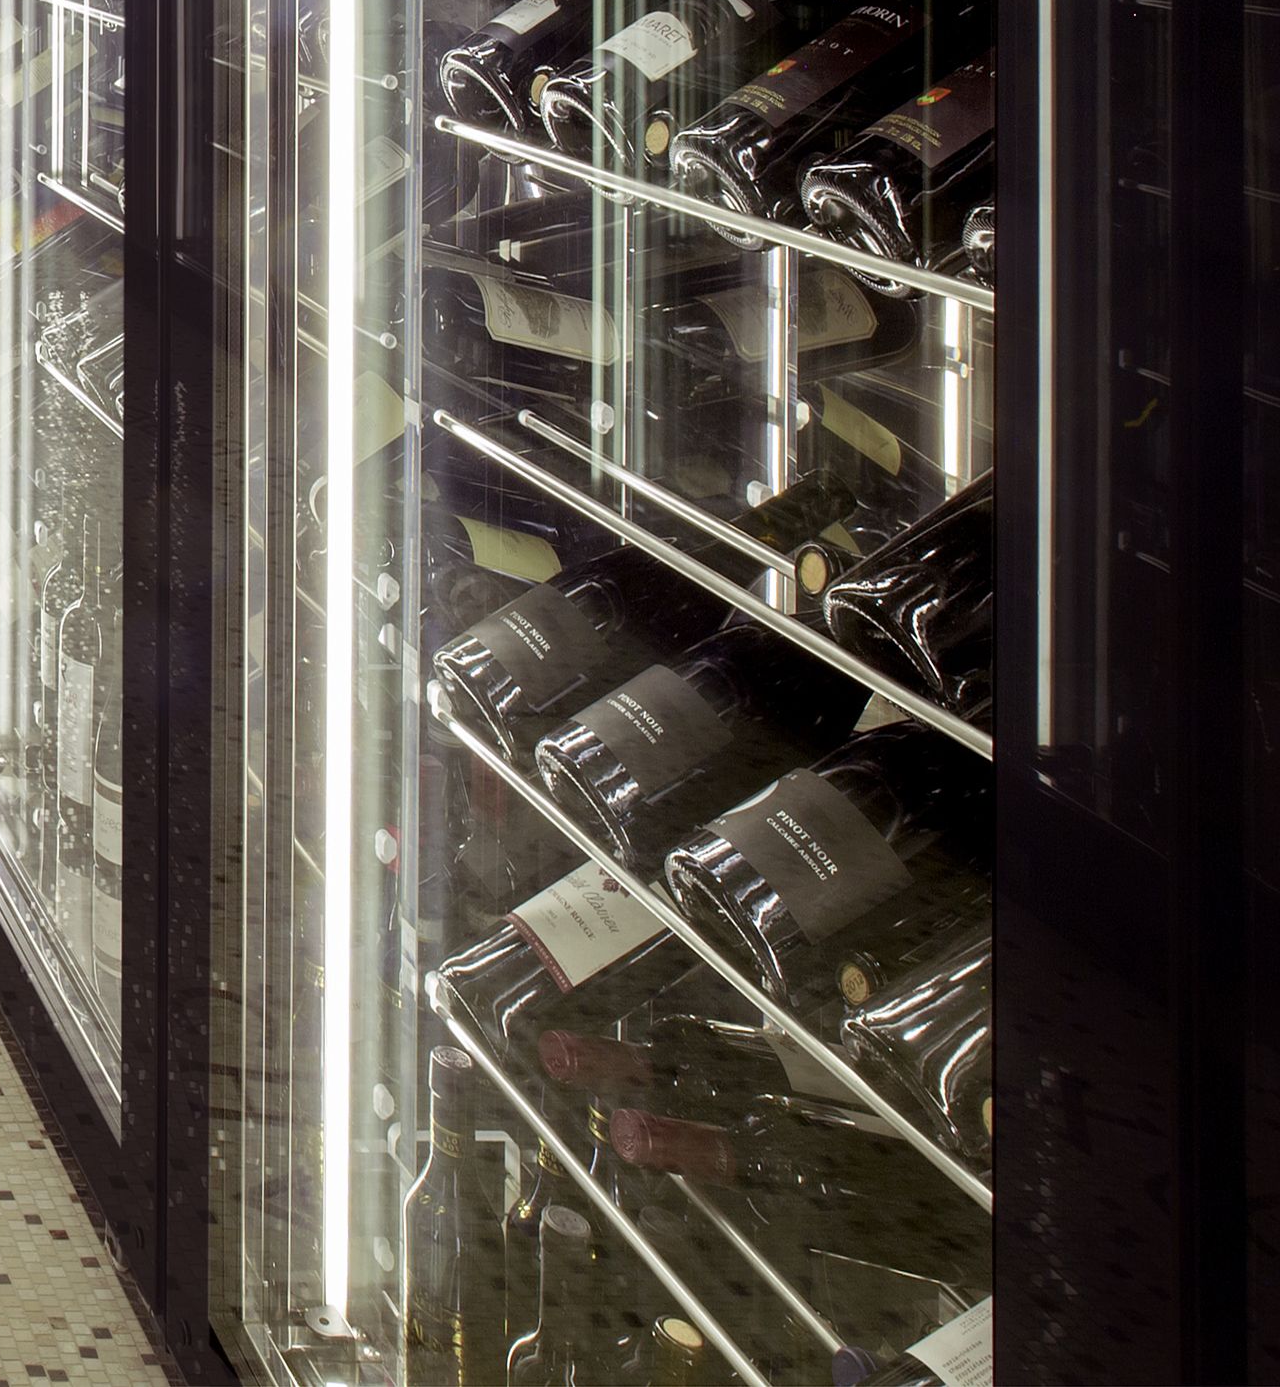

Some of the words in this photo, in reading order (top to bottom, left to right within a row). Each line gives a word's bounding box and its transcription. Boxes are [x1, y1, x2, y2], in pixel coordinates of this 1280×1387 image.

[510, 610, 533, 631] PINOT
[529, 627, 552, 653] NOIR
[617, 692, 642, 713] PINOT
[640, 710, 665, 736] NOIR
[765, 816, 800, 850] CALCAIRE
[797, 847, 828, 882] ABSOLU
[775, 809, 811, 841] PINOT
[807, 840, 839, 876] NOIR
[570, 910, 598, 942] ROUGE
